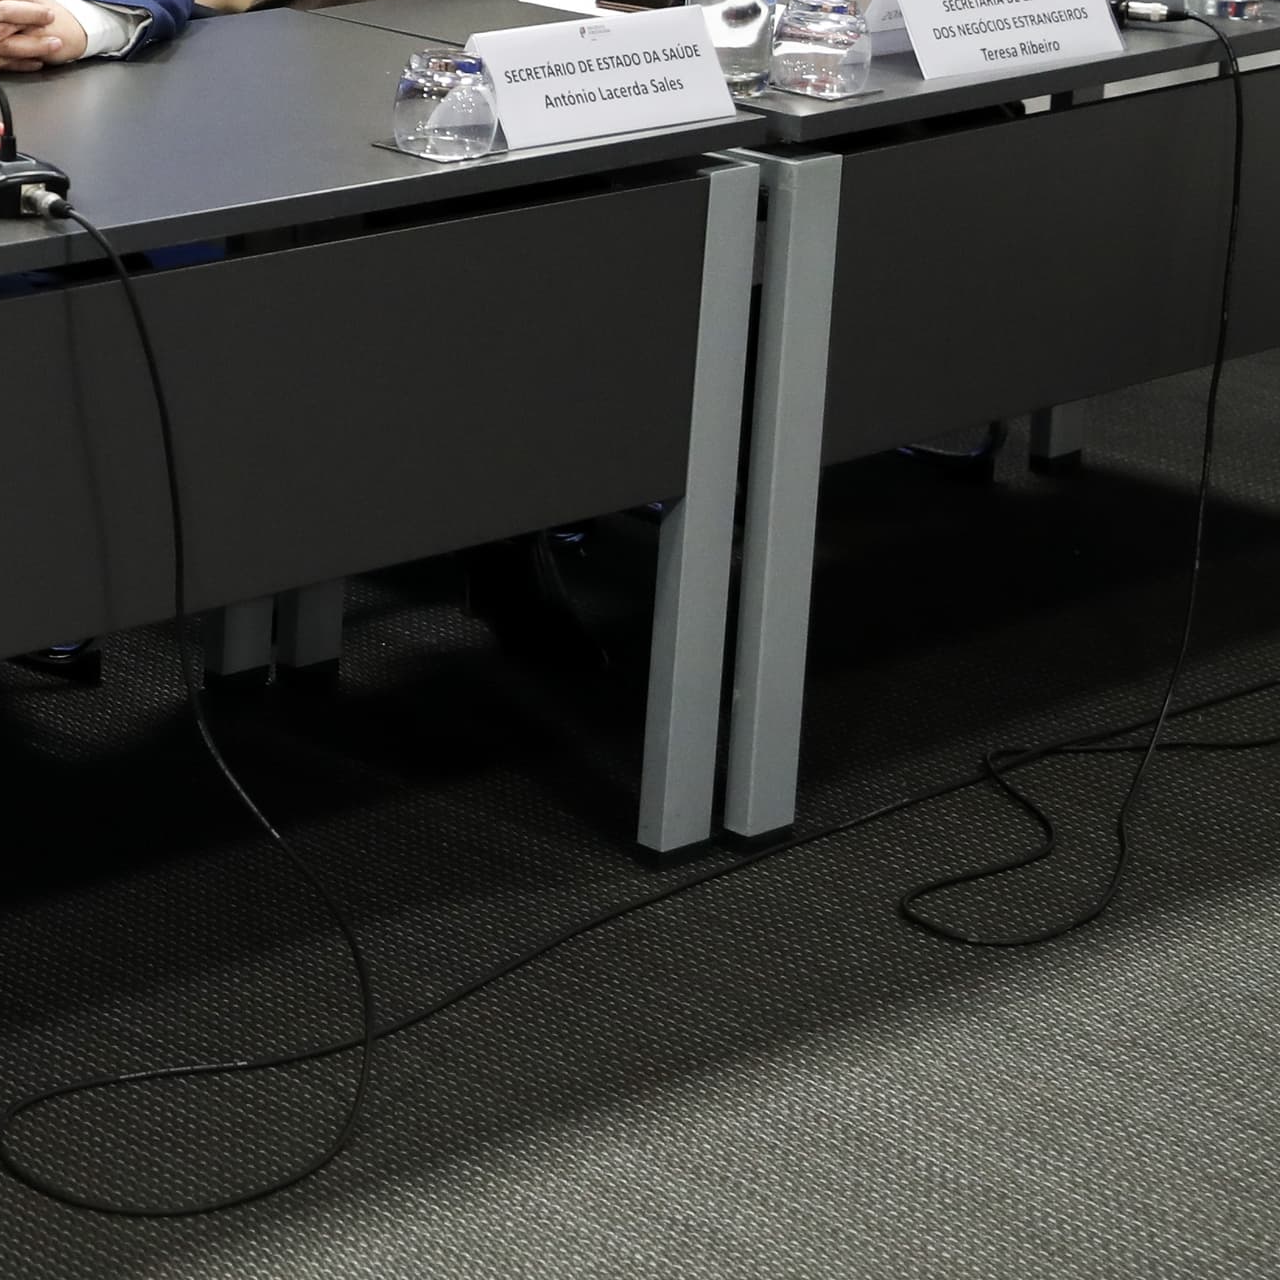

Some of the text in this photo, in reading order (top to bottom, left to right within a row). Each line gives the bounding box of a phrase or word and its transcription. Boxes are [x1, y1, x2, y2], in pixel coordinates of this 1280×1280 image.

[933, 7, 1088, 40] DOS NEGÓCIOS ESTRANGEIROS
[504, 43, 701, 84] SECRETÁRIO DE ESTADO DA SAÚDE
[980, 38, 1060, 62] Teresa Ribeiro
[545, 76, 684, 109] António Lacerda Sales
